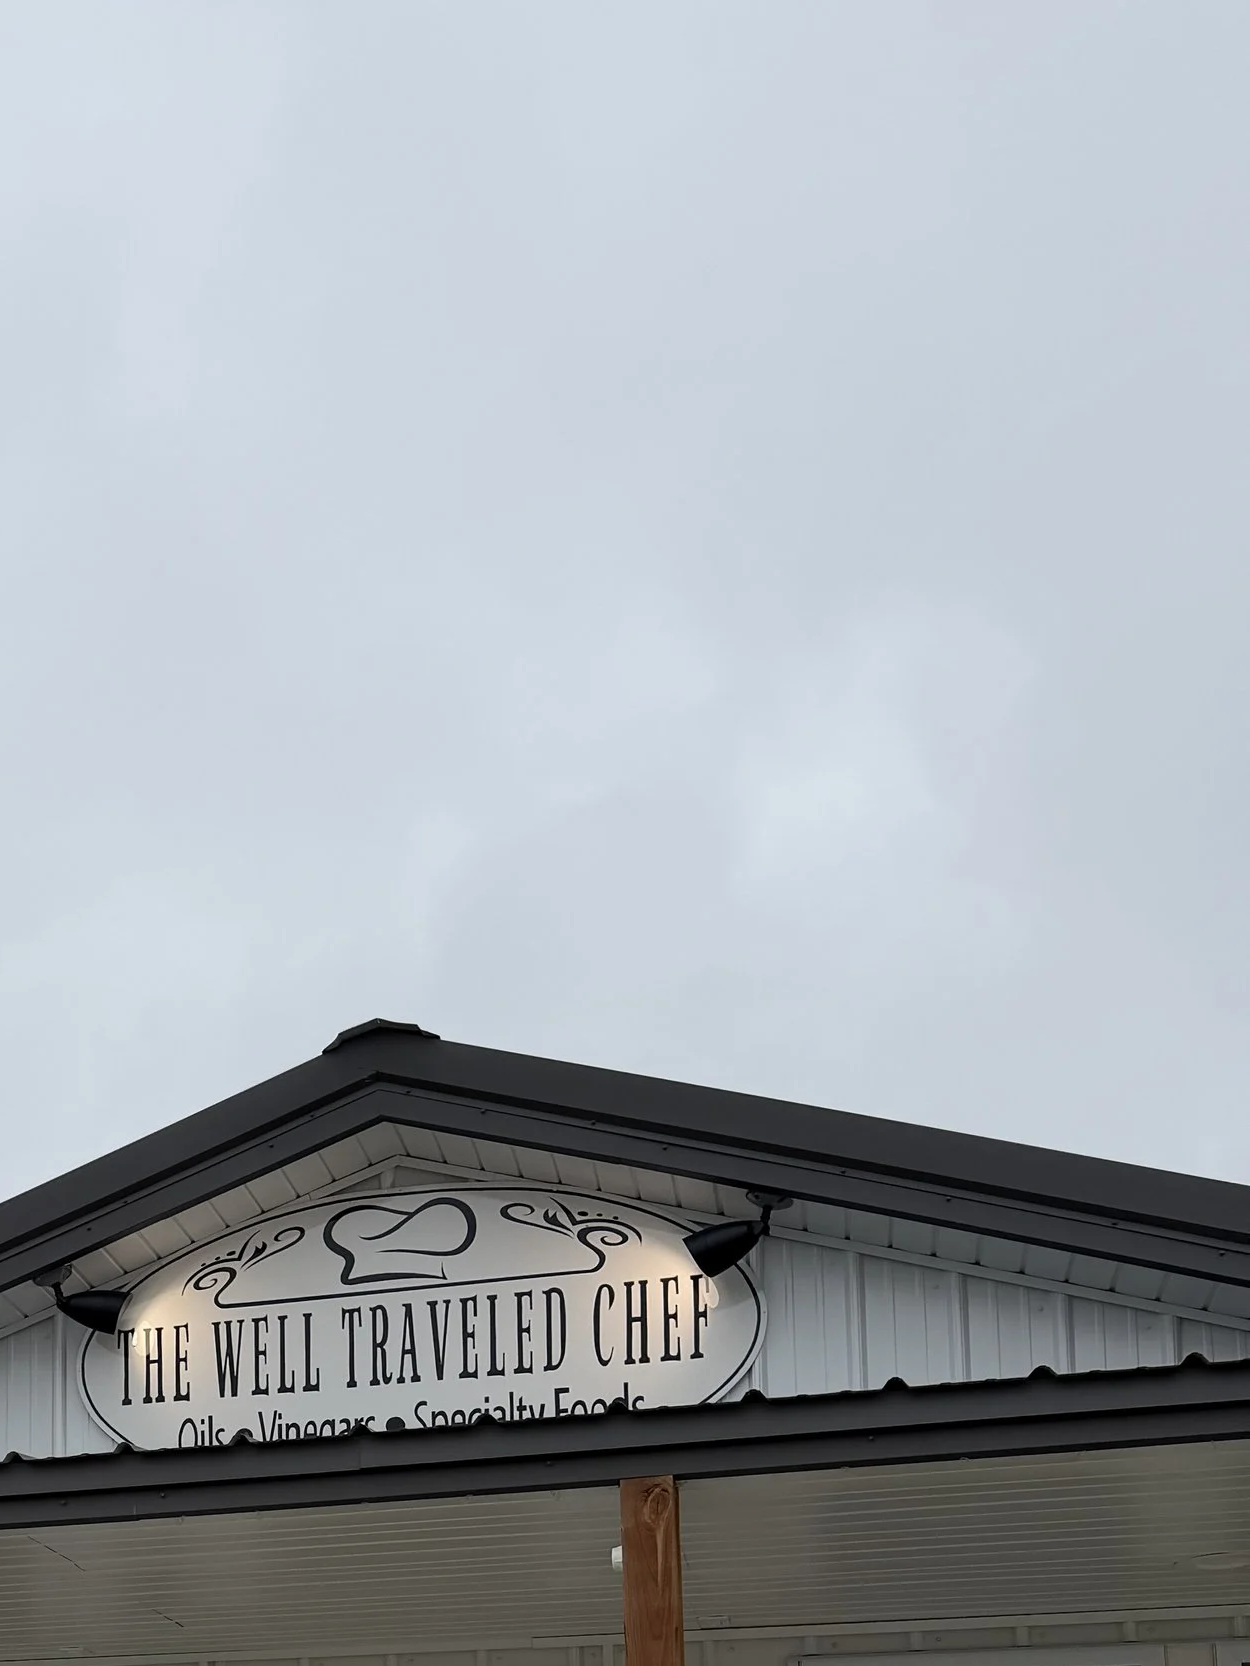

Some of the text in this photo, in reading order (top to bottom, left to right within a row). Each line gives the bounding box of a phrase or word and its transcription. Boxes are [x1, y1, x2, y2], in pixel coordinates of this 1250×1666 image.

[117, 1274, 710, 1406] THE WELL TRAVELED CHEF
[178, 1415, 226, 1448] Oils
